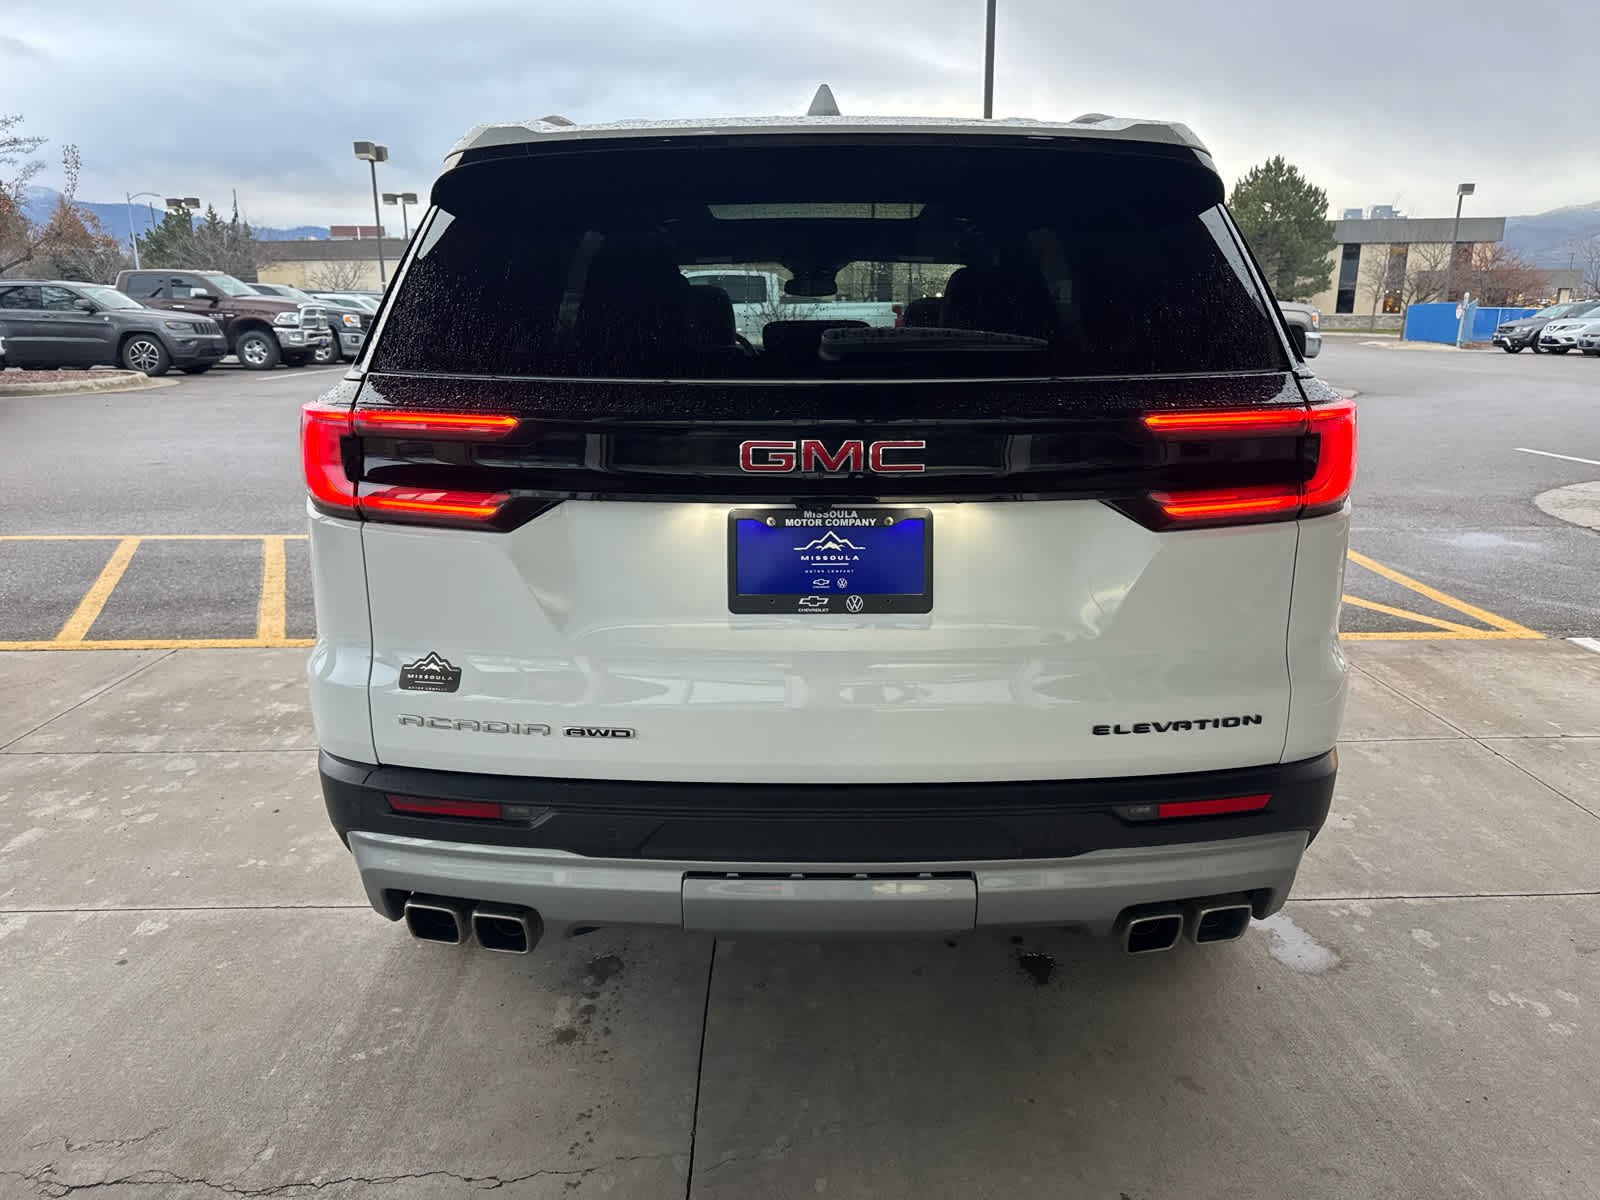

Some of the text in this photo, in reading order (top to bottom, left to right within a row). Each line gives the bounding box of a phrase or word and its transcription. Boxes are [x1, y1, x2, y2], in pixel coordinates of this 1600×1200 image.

[739, 440, 926, 472] GMC
[803, 510, 858, 518] MISSOULA
[785, 518, 877, 527] MOTOR COMPANY
[407, 673, 454, 681] MISSOULA
[398, 713, 632, 738] ACADIA AWD
[1092, 714, 1263, 736] ELEVATION
